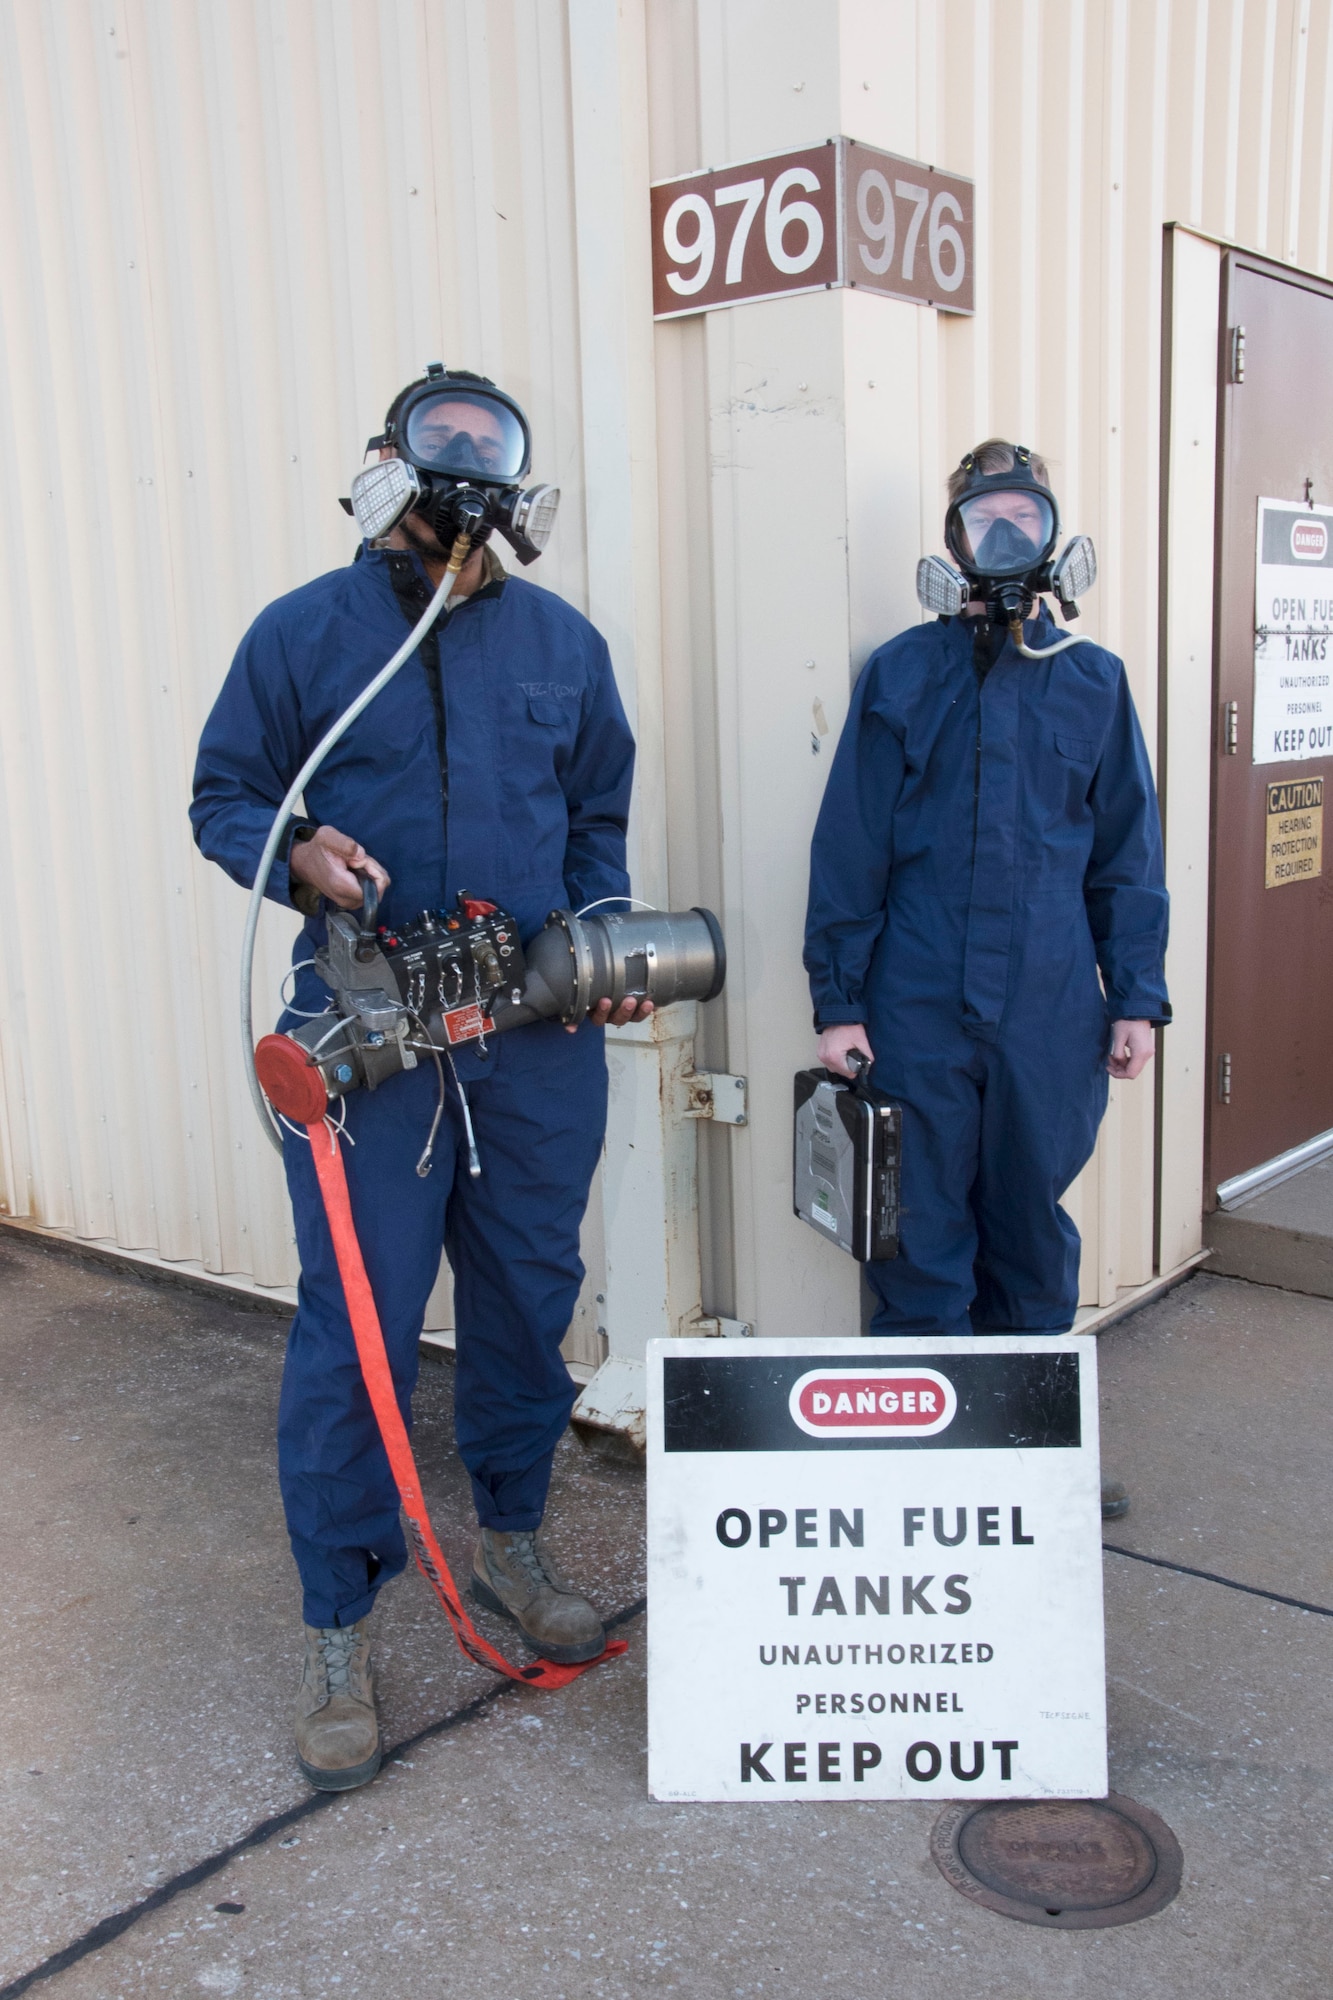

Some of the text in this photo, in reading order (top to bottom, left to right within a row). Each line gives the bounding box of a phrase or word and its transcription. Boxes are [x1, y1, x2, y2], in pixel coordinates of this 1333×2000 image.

[663, 167, 824, 296] 976
[856, 168, 966, 293] 976
[1295, 533, 1324, 547] DANGER
[1272, 597, 1306, 621] OPEN
[1286, 635, 1327, 661] TANKS
[1280, 675, 1329, 688] UNAUTHORIZED
[1287, 702, 1322, 715] PERSONNEL
[1274, 726, 1333, 752] KEEP OUT
[1269, 783, 1321, 812] CAUTION
[1279, 815, 1312, 835] HEARING
[1271, 836, 1318, 858] PROTECTION
[1275, 858, 1313, 879] REQUIRED
[811, 1389, 938, 1415] DANGER
[716, 1506, 1035, 1549] OPEN FUEL
[779, 1574, 972, 1616] TANKS
[759, 1642, 995, 1666] UNAUTHORIZED
[796, 1692, 964, 1715] PERSONNEL
[740, 1740, 1020, 1783] KEEP OUT
